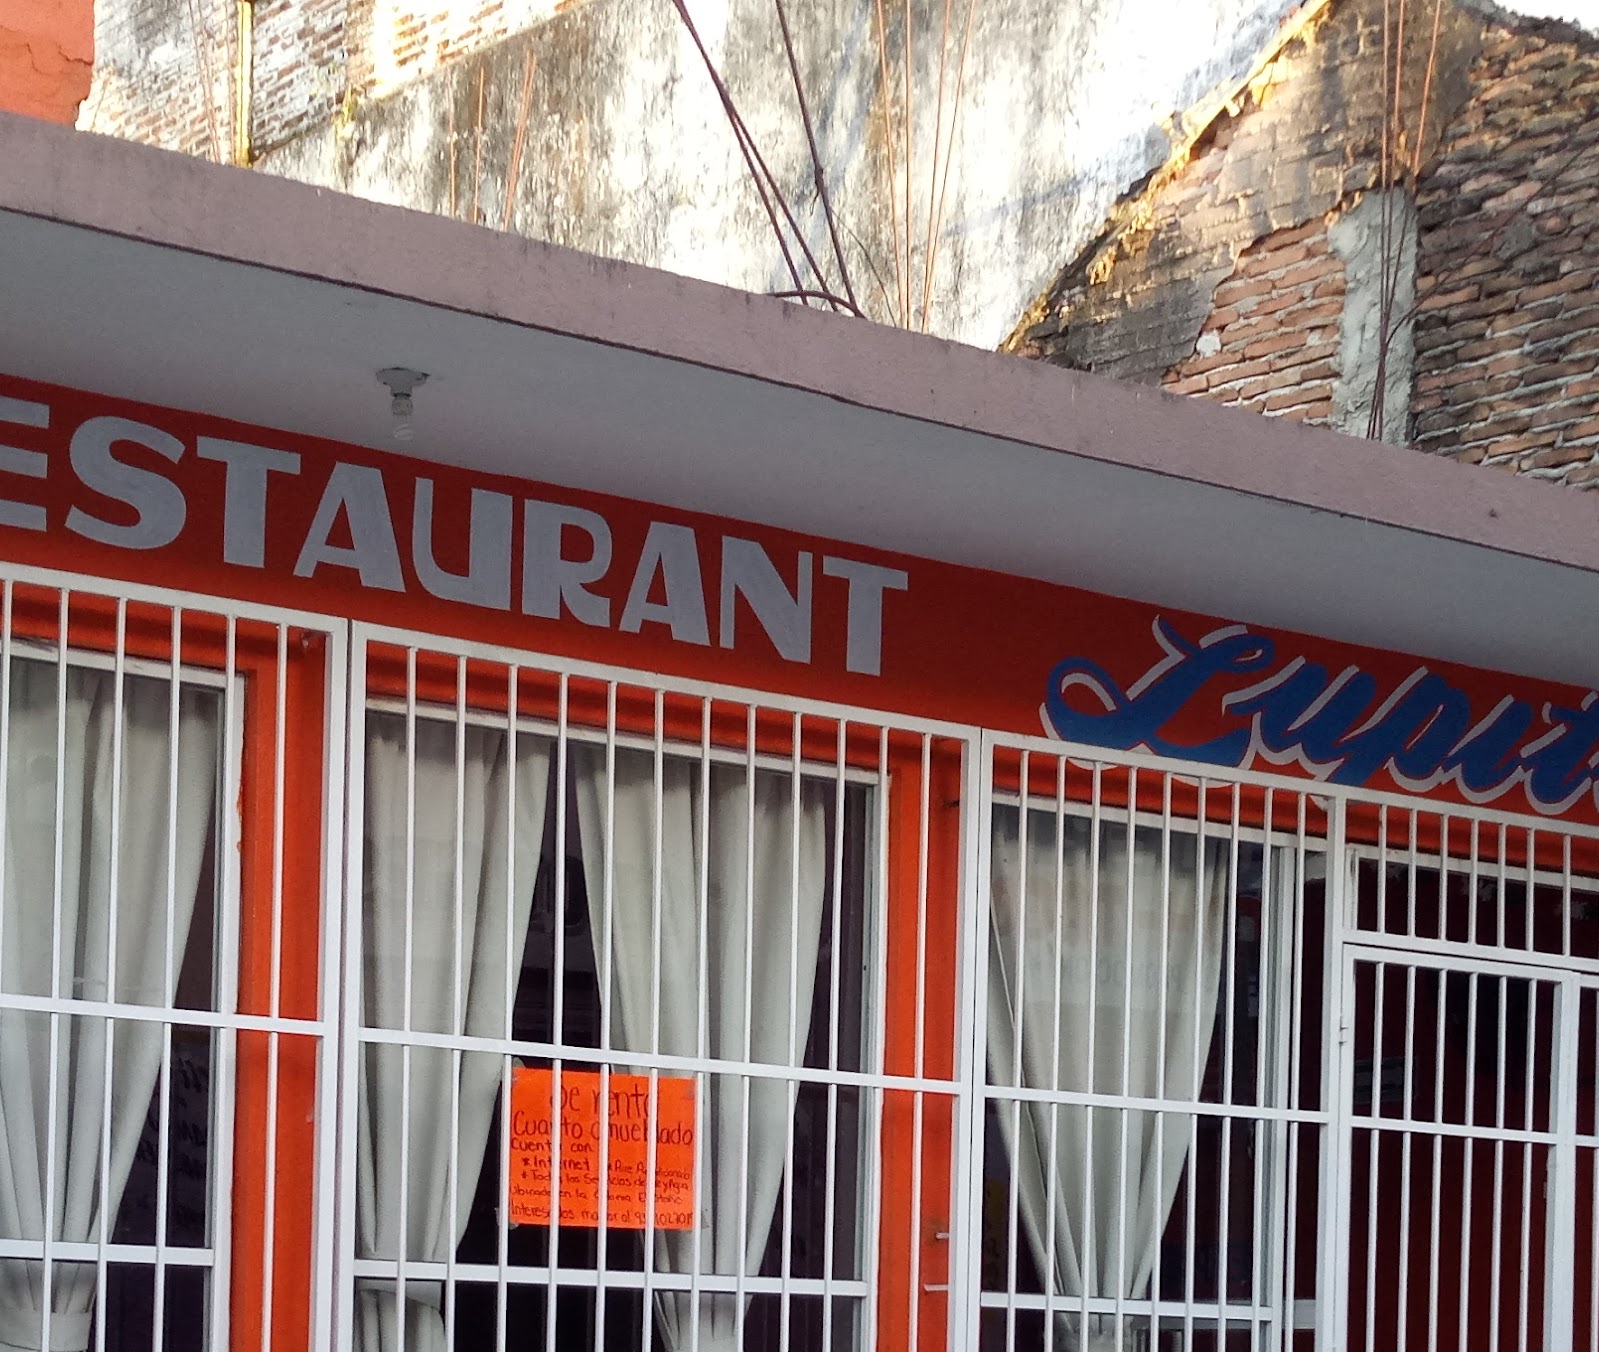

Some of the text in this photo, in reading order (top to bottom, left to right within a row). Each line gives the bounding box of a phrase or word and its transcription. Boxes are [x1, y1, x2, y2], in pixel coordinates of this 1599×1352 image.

[513, 1110, 694, 1146] Cuato amueado
[511, 1137, 594, 1153] Cuent con
[533, 1156, 590, 1171] Intrnet
